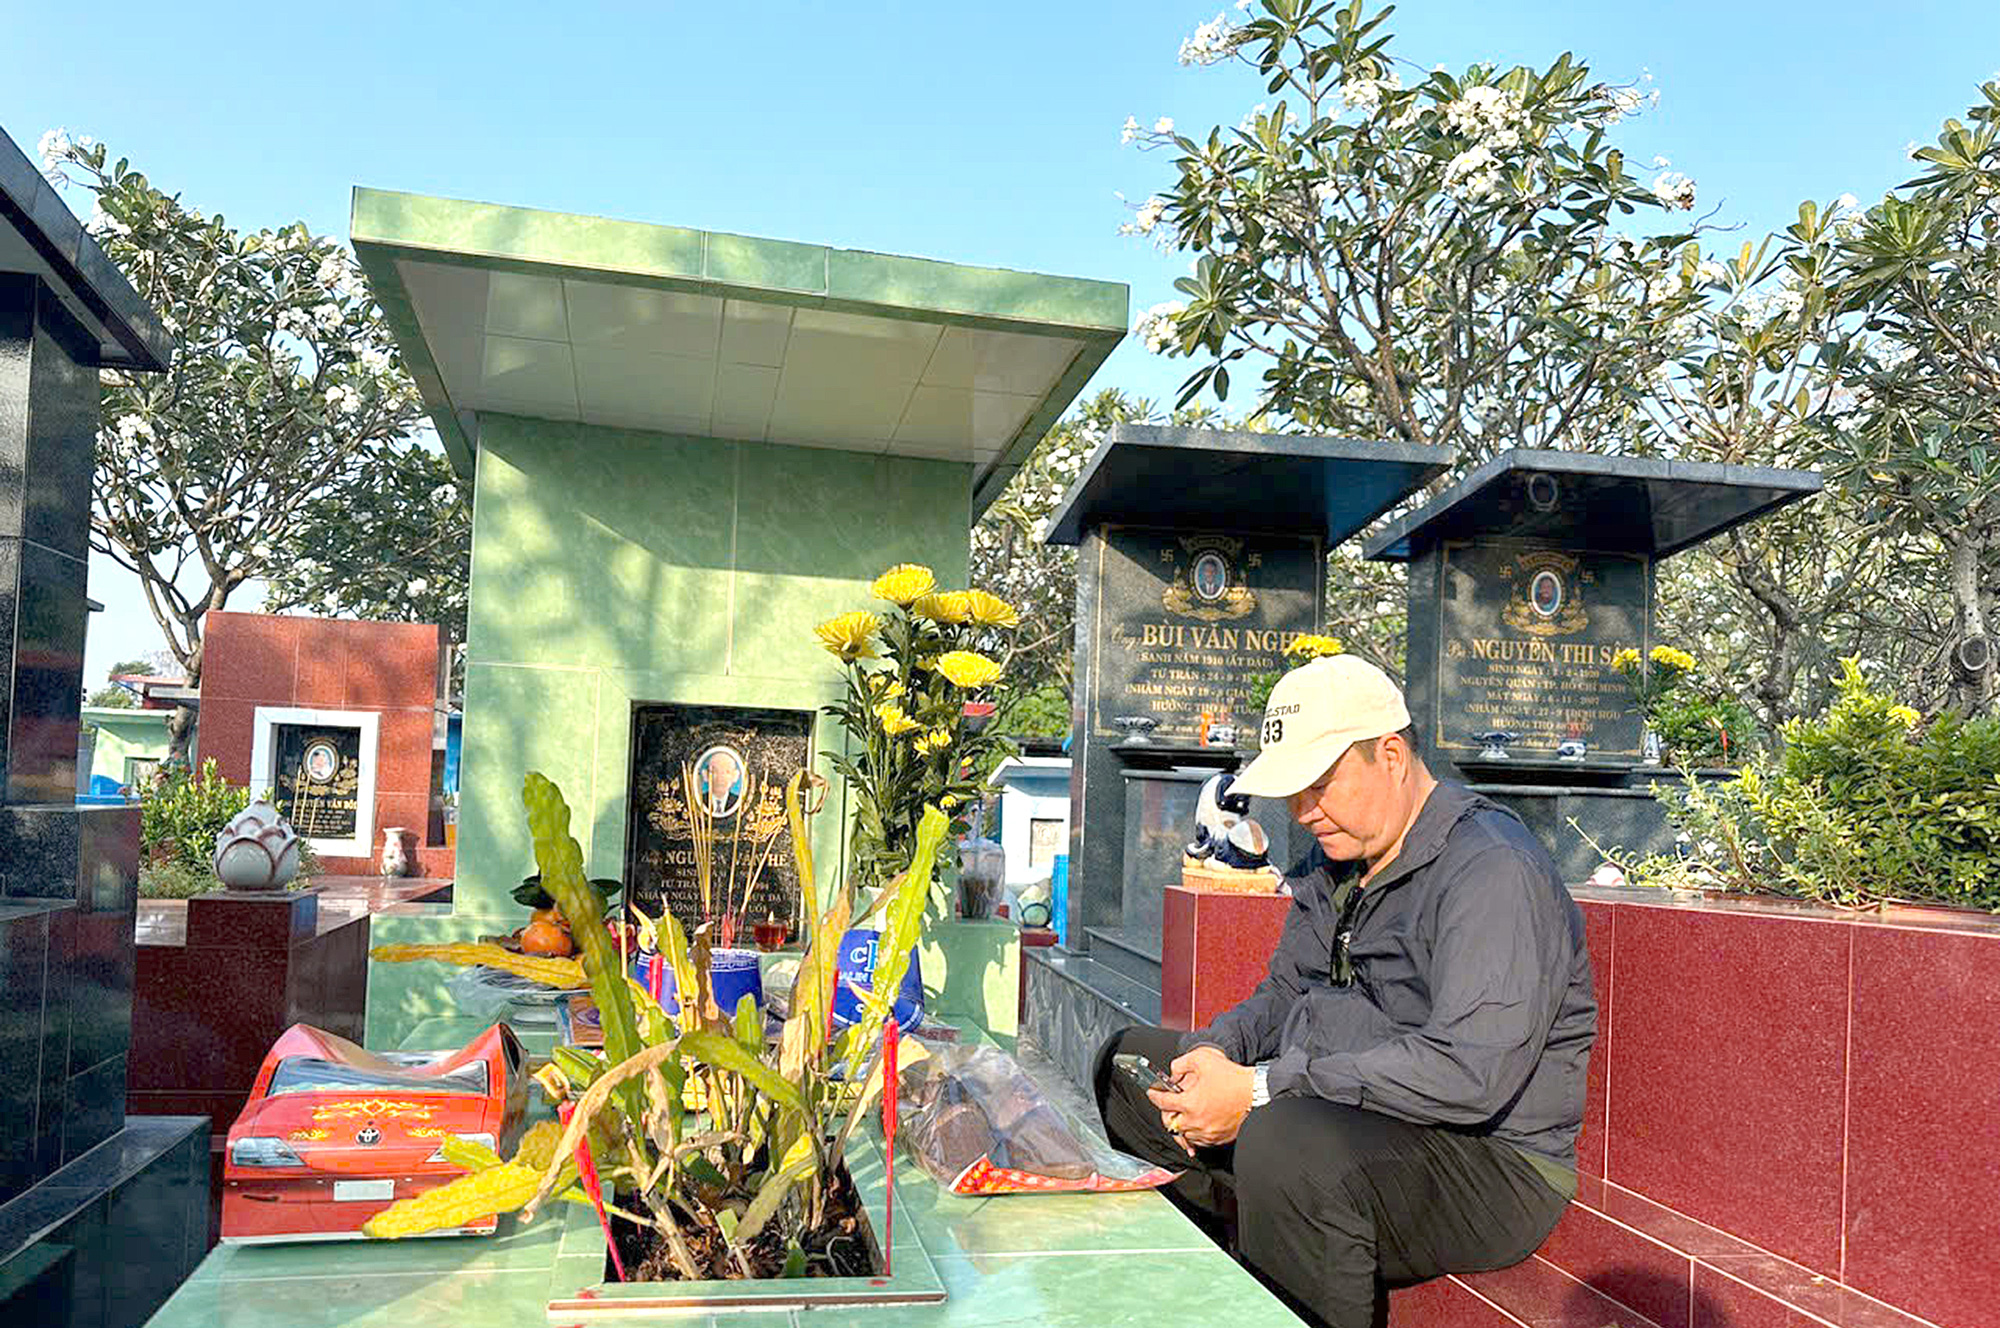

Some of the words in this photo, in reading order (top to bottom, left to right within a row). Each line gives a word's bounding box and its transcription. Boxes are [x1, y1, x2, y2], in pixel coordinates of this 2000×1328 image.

[1142, 619, 1184, 647] BÙI
[1190, 623, 1240, 650] VĂN
[1245, 629, 1300, 652] NGH
[1471, 636, 1554, 663] NGUYỄN
[1560, 644, 1595, 668] THỊ
[1263, 718, 1283, 745] 33
